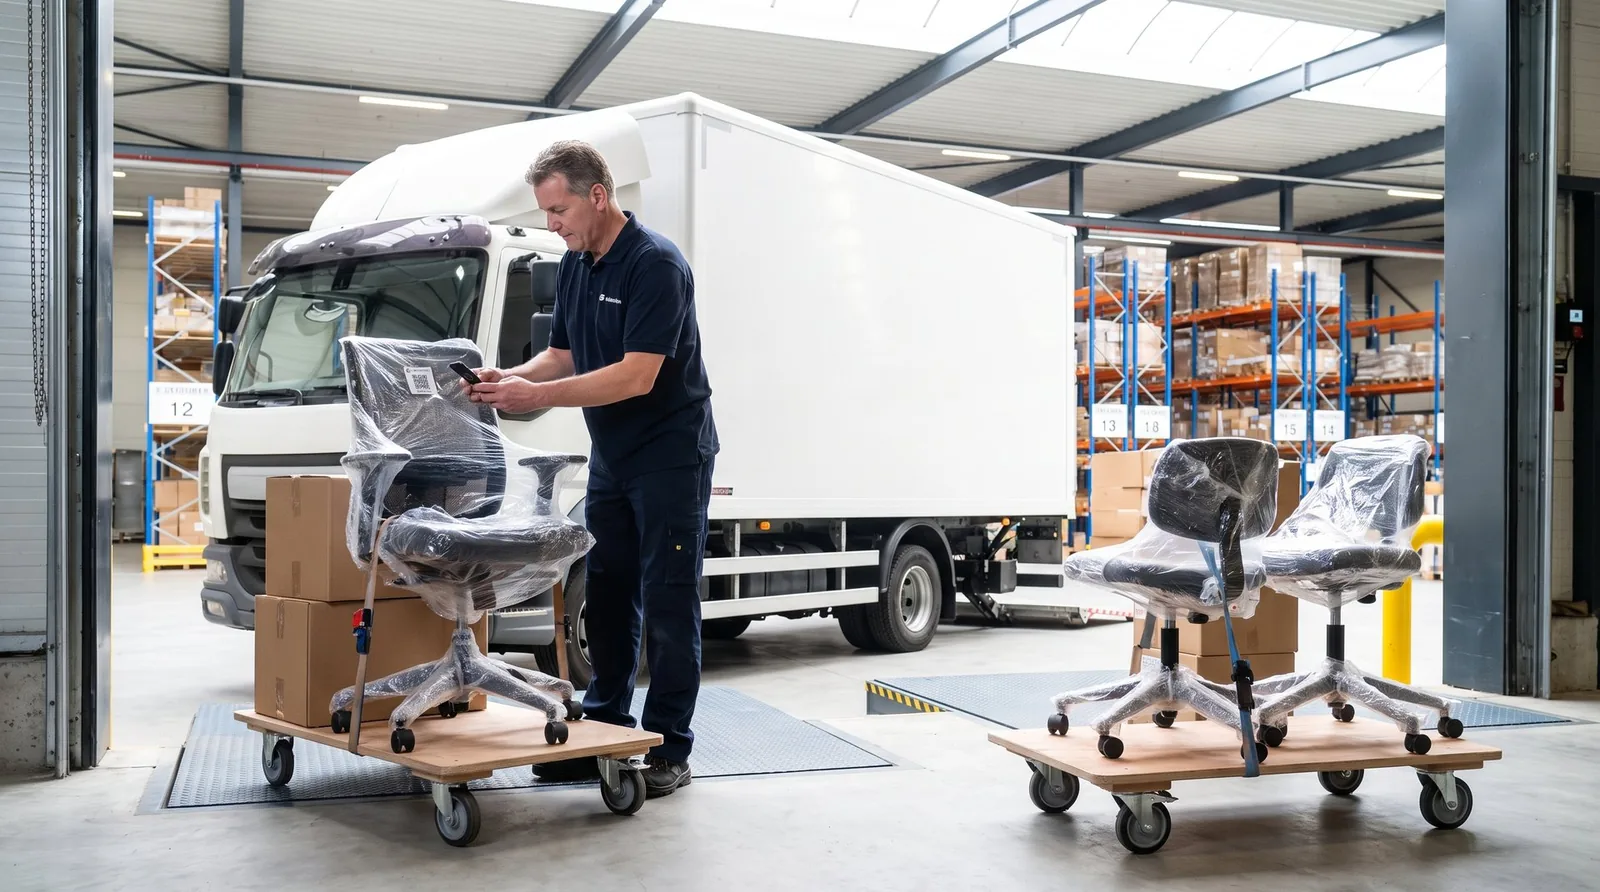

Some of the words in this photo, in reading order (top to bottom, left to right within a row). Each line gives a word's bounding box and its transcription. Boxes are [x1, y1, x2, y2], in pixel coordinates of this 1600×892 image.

[171, 402, 193, 417] 12
[1102, 420, 1116, 432] 13
[1145, 421, 1159, 433] 18
[1284, 424, 1297, 436] 15
[1322, 425, 1334, 436] 14
